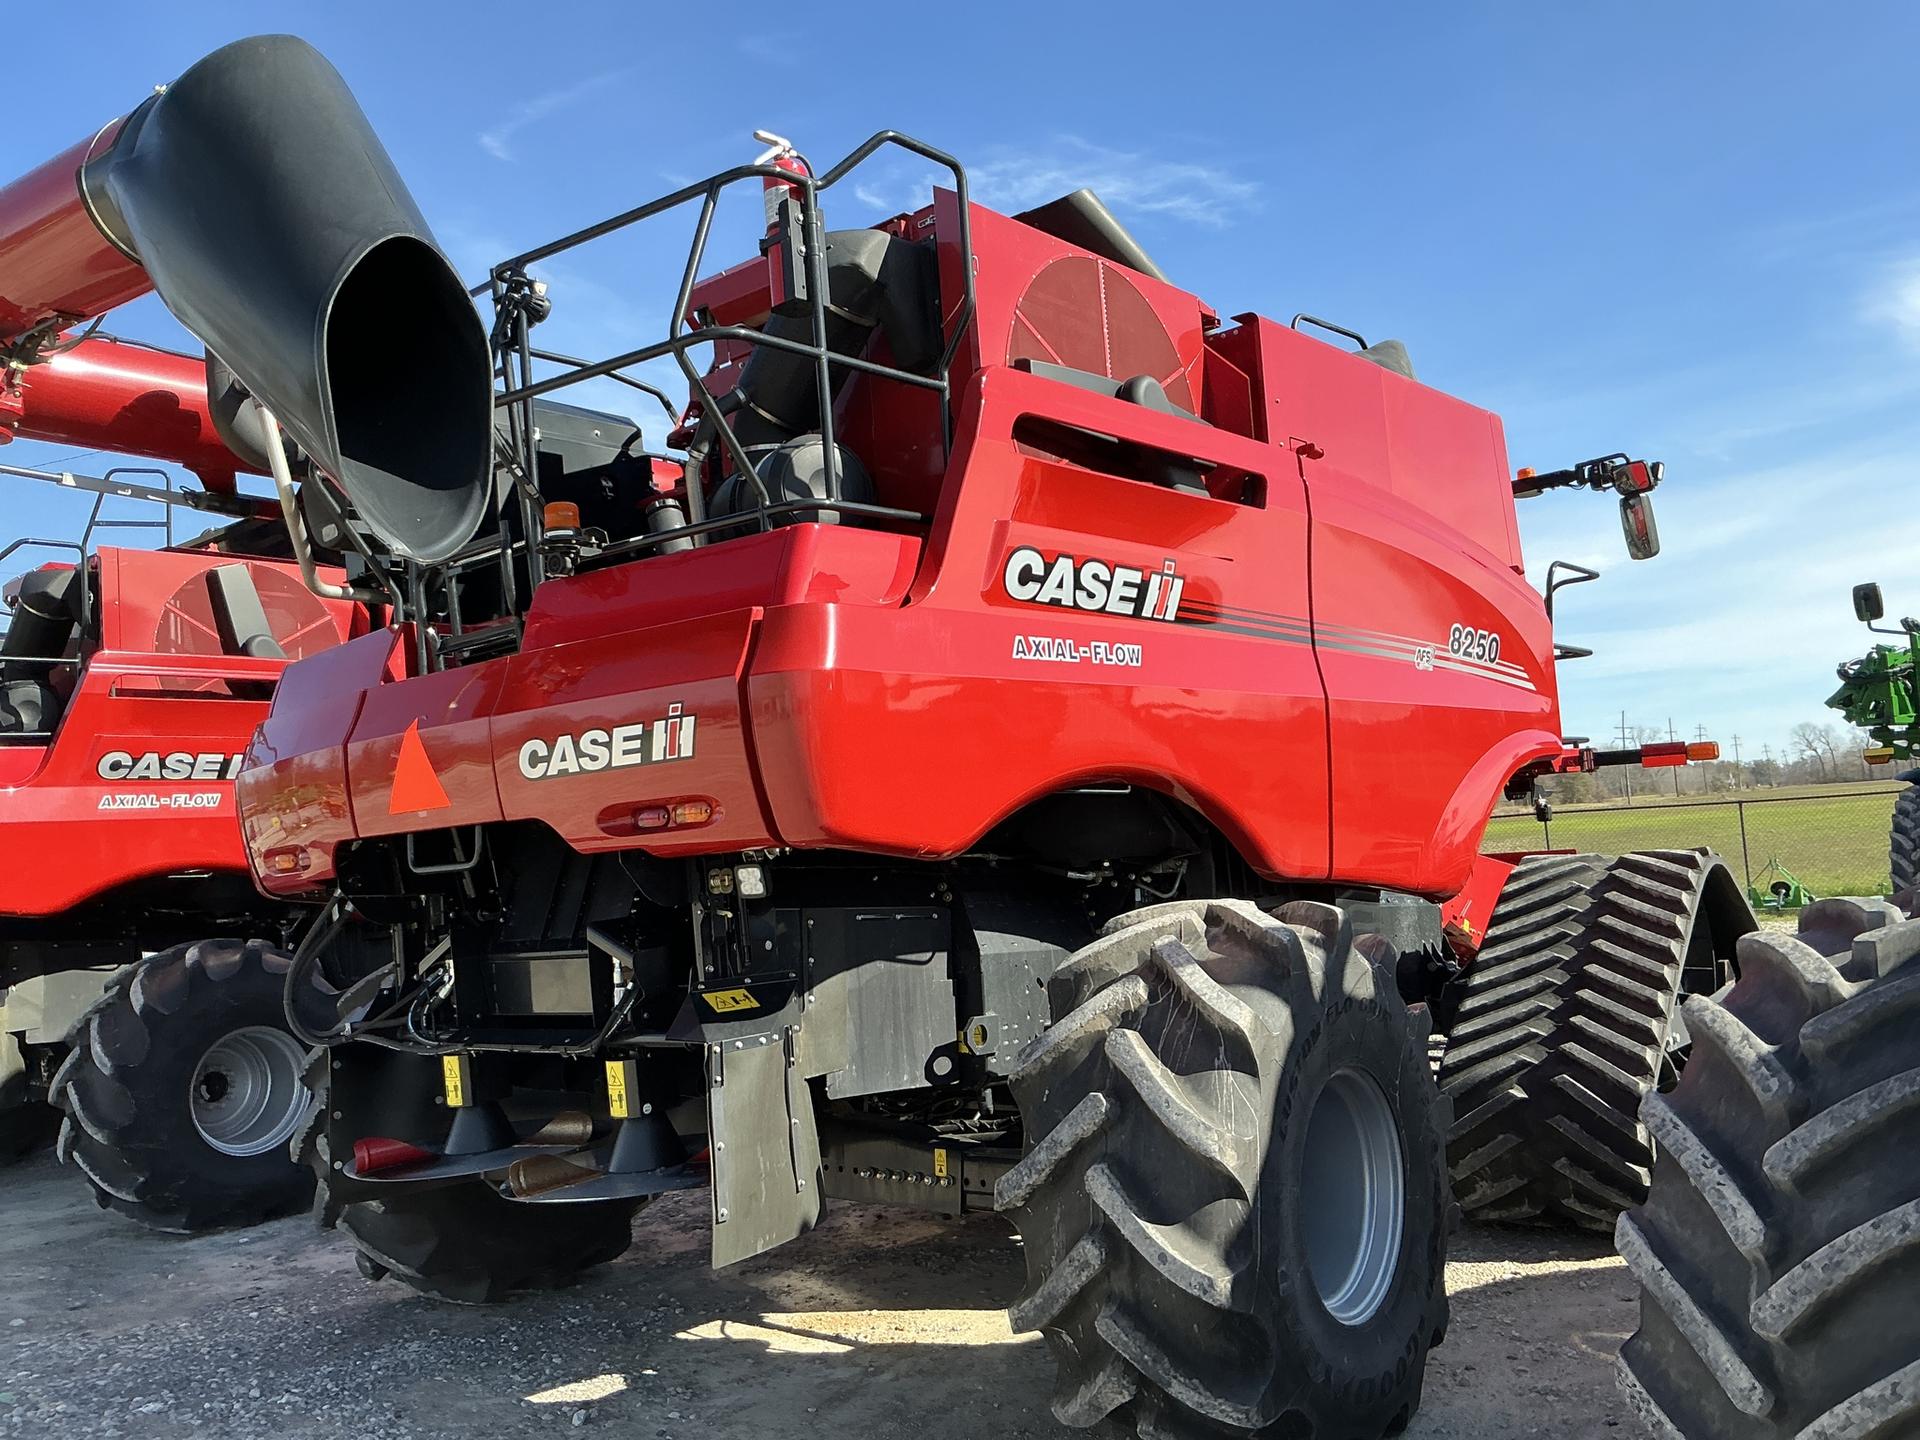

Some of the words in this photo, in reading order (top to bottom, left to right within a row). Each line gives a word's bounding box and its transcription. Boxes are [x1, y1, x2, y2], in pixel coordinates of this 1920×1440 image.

[1005, 548, 1143, 615] CASE
[1012, 635, 1142, 667] AXIAL-FLOW
[1449, 622, 1501, 665] 8250
[98, 751, 224, 780] CASE
[519, 723, 644, 779] CASE
[98, 793, 221, 809] AXIAL-FLOW
